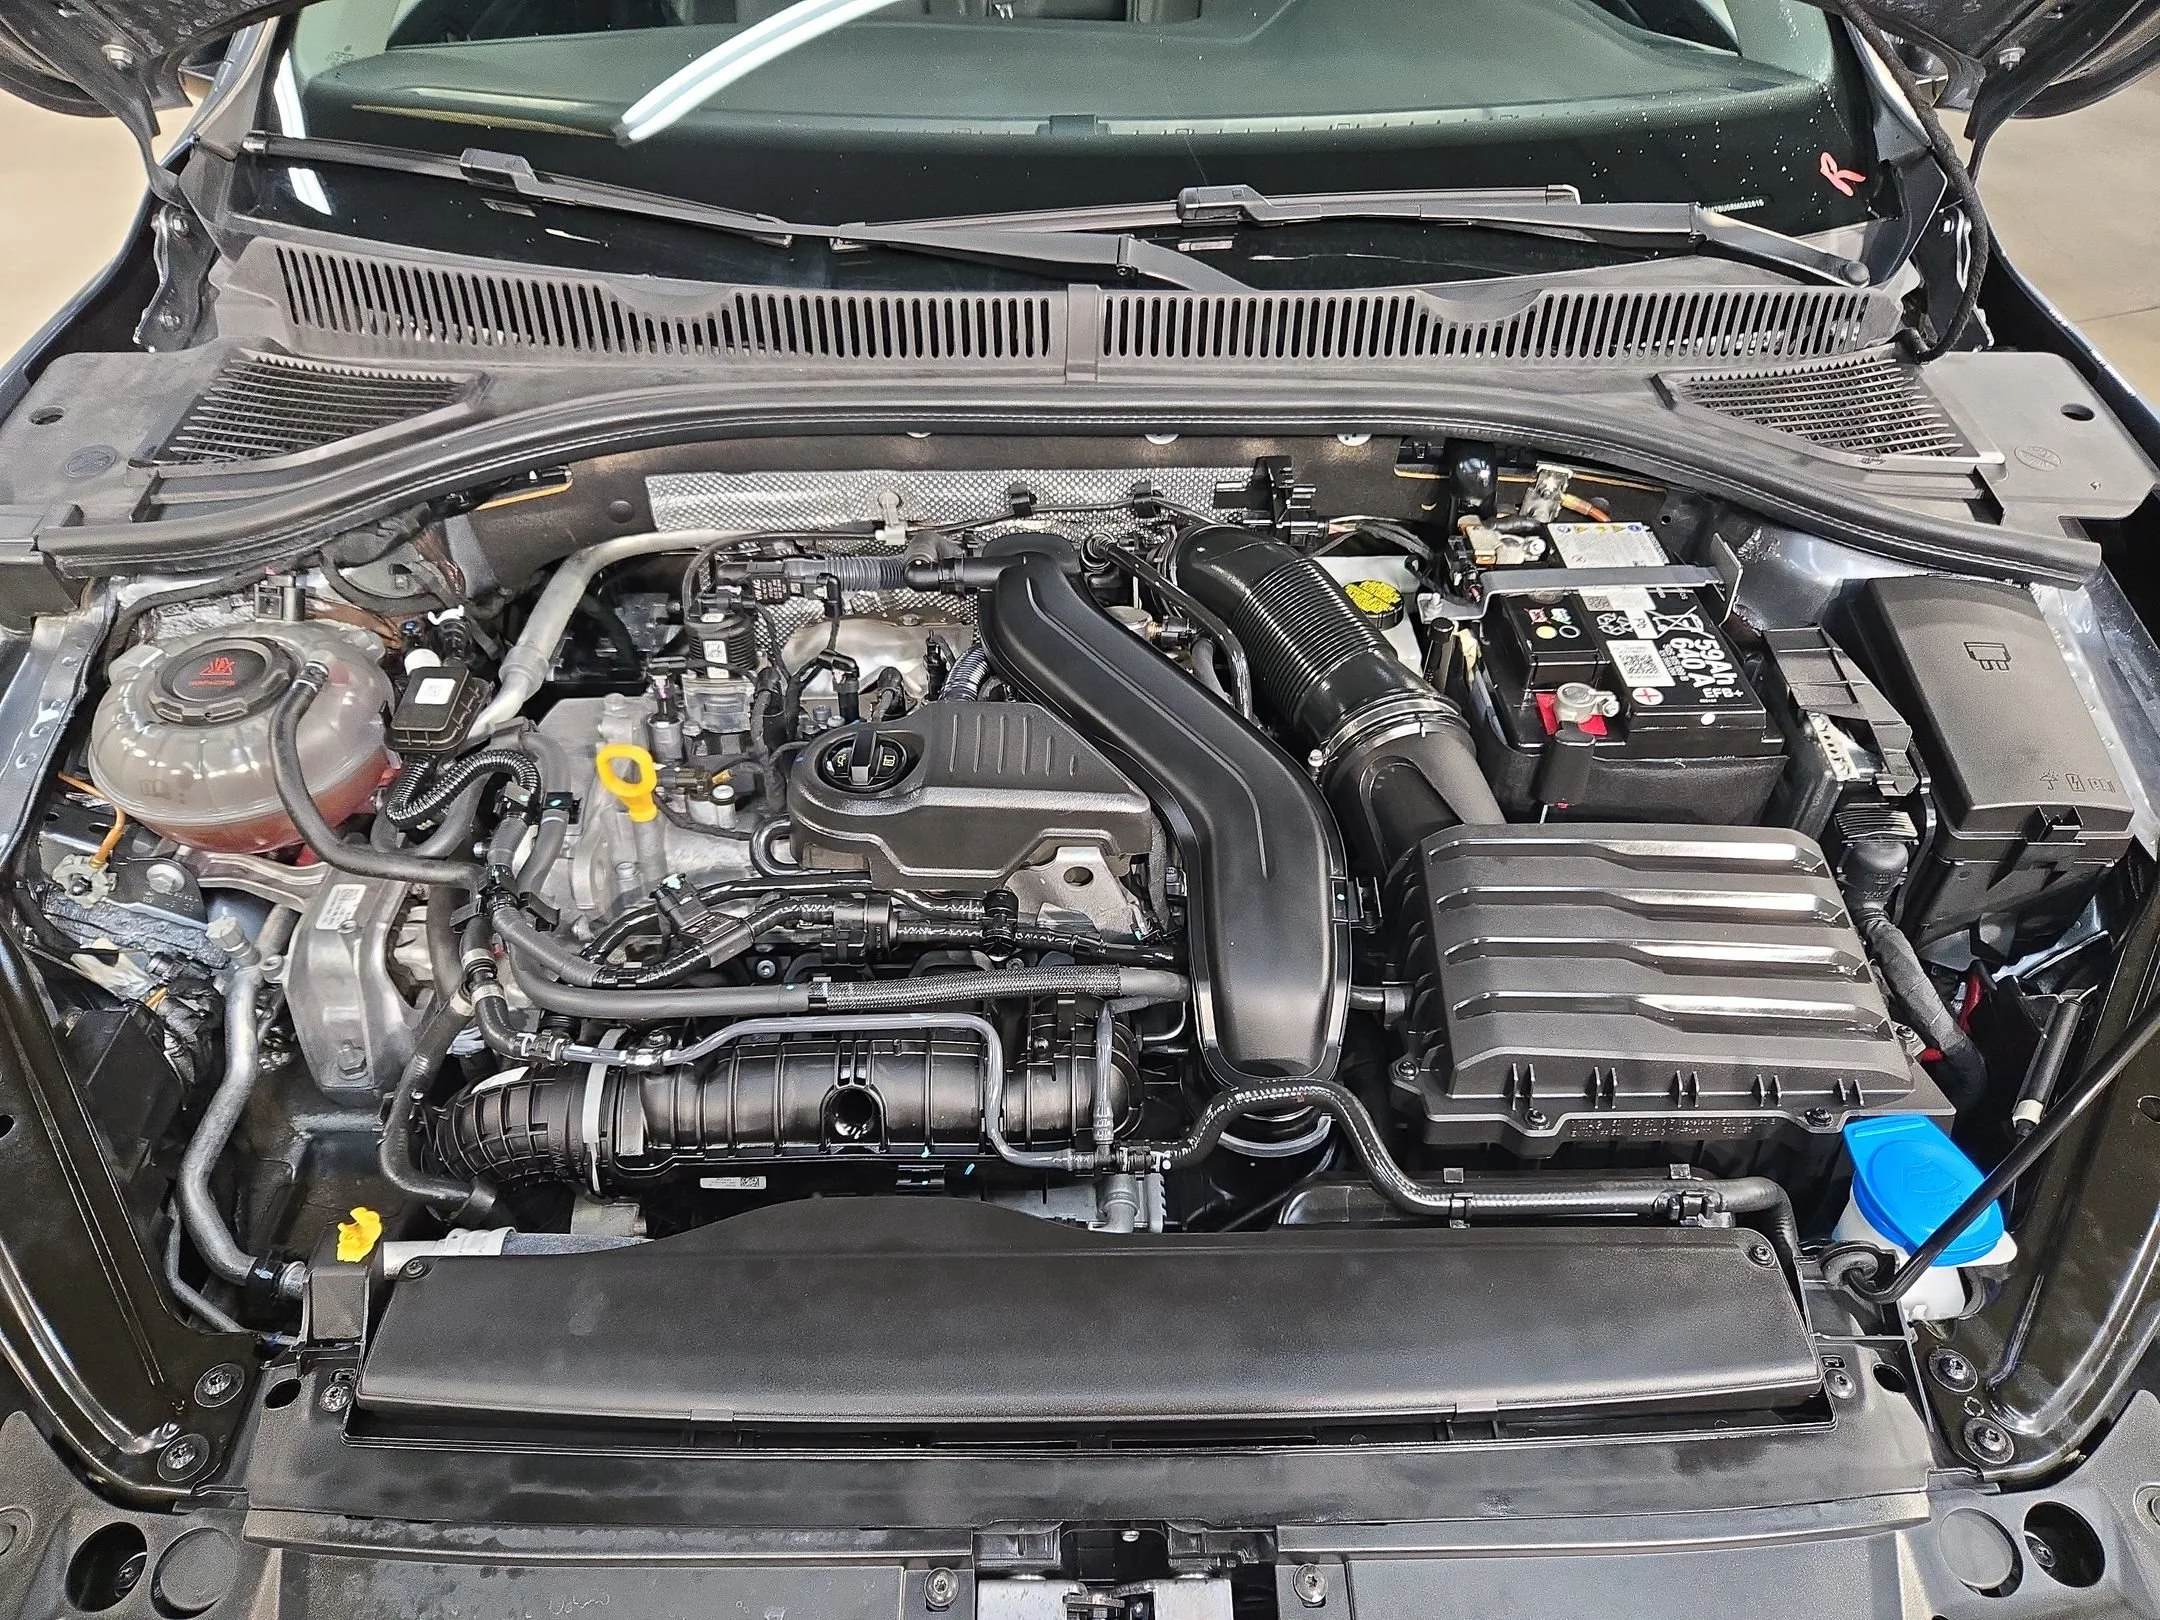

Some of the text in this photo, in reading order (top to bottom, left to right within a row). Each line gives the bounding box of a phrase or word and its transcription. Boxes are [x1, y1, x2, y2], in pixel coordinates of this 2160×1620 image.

[1820, 151, 1866, 197] R
[1670, 638, 1706, 669] 640
[1688, 672, 1715, 687] A
[1694, 639, 1737, 685] 59Ah
[1702, 688, 1744, 698] EFB+
